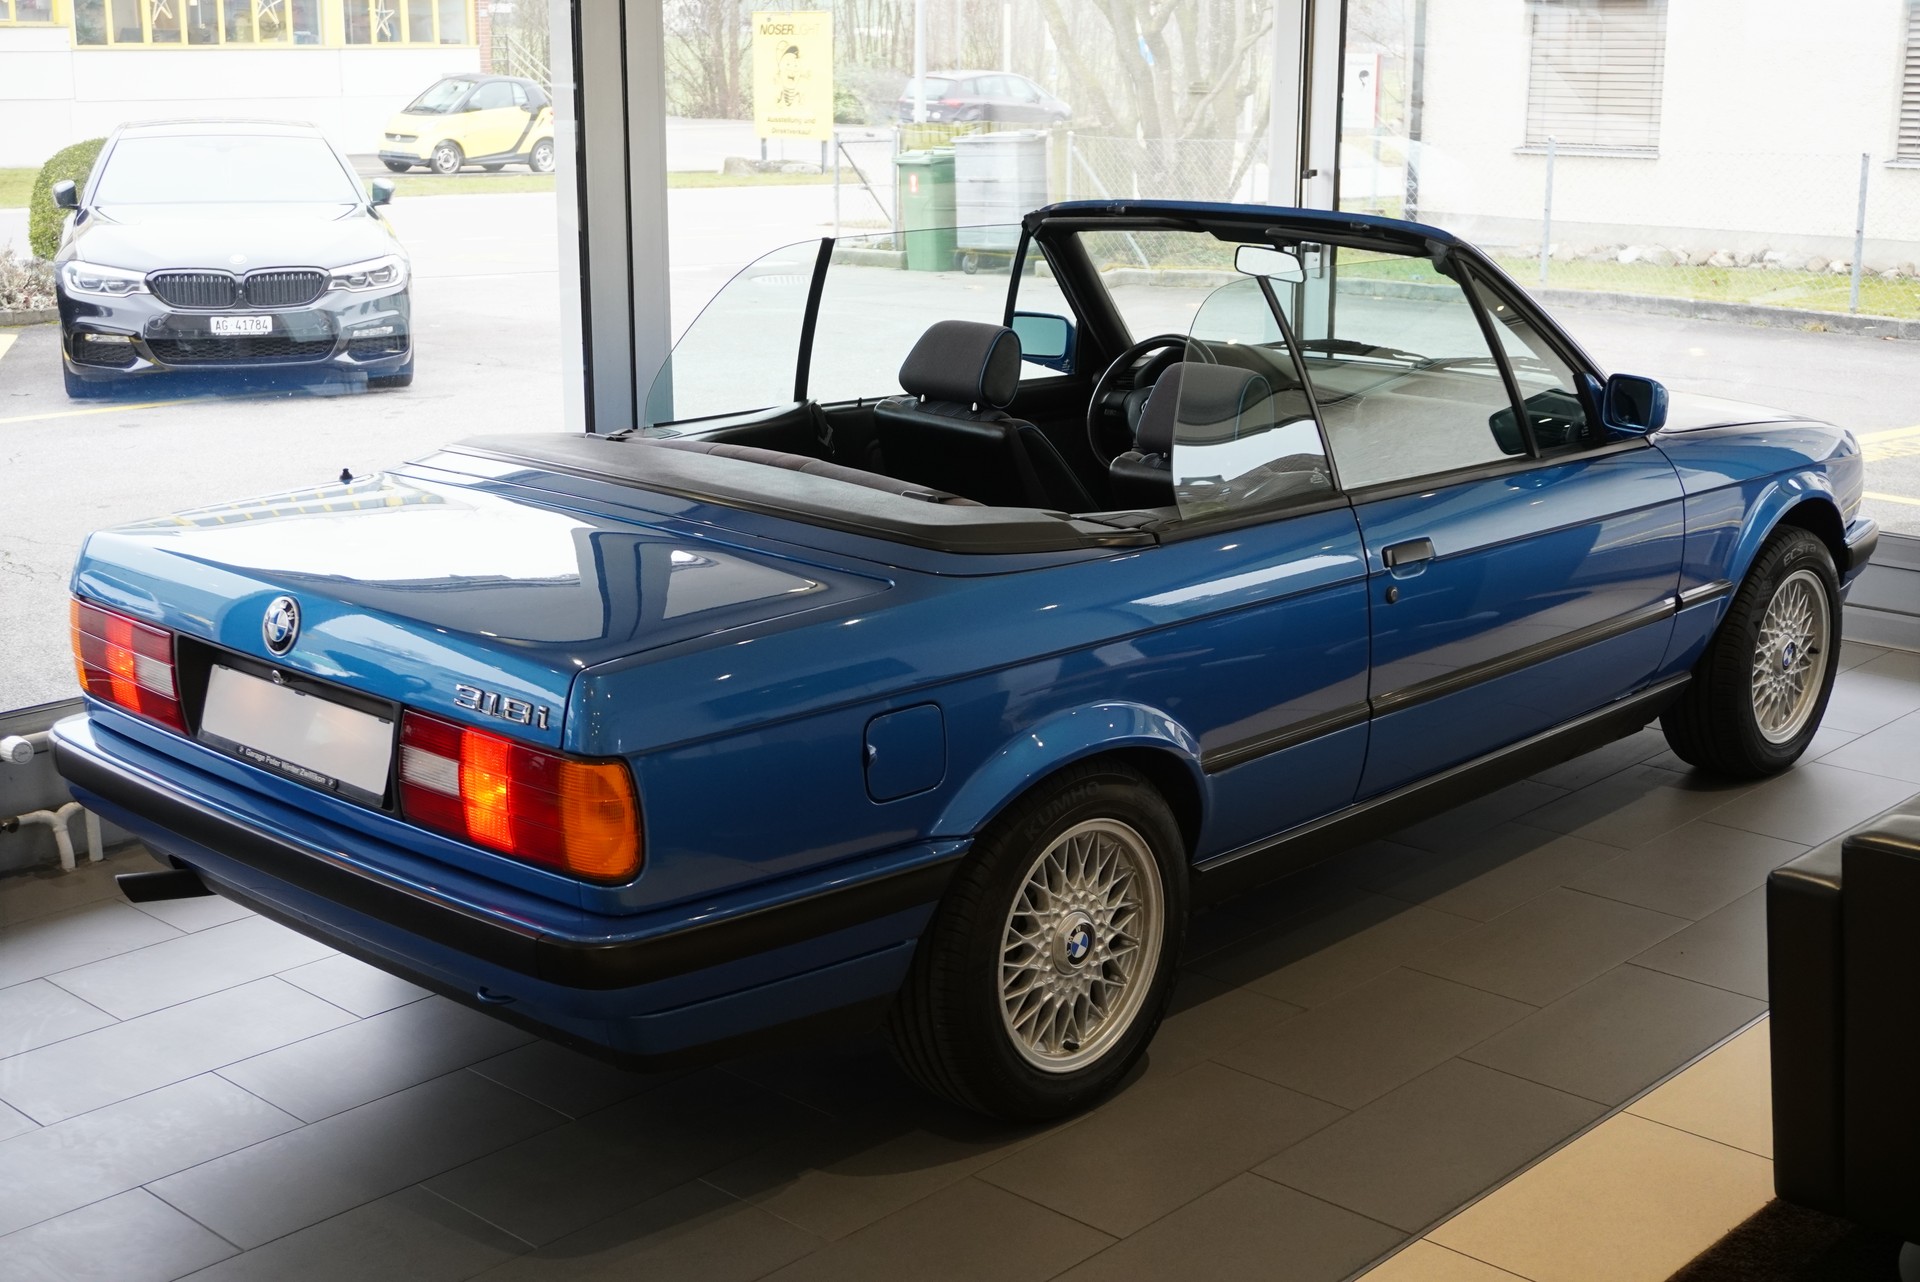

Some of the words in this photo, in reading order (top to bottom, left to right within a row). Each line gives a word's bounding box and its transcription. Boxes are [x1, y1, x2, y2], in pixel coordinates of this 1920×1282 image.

[216, 320, 228, 331] AG
[235, 320, 268, 331] 41784
[453, 683, 550, 731] 318i
[245, 748, 266, 762] Garage
[265, 755, 281, 767] Peter
[1024, 781, 1100, 841] KUMHO
